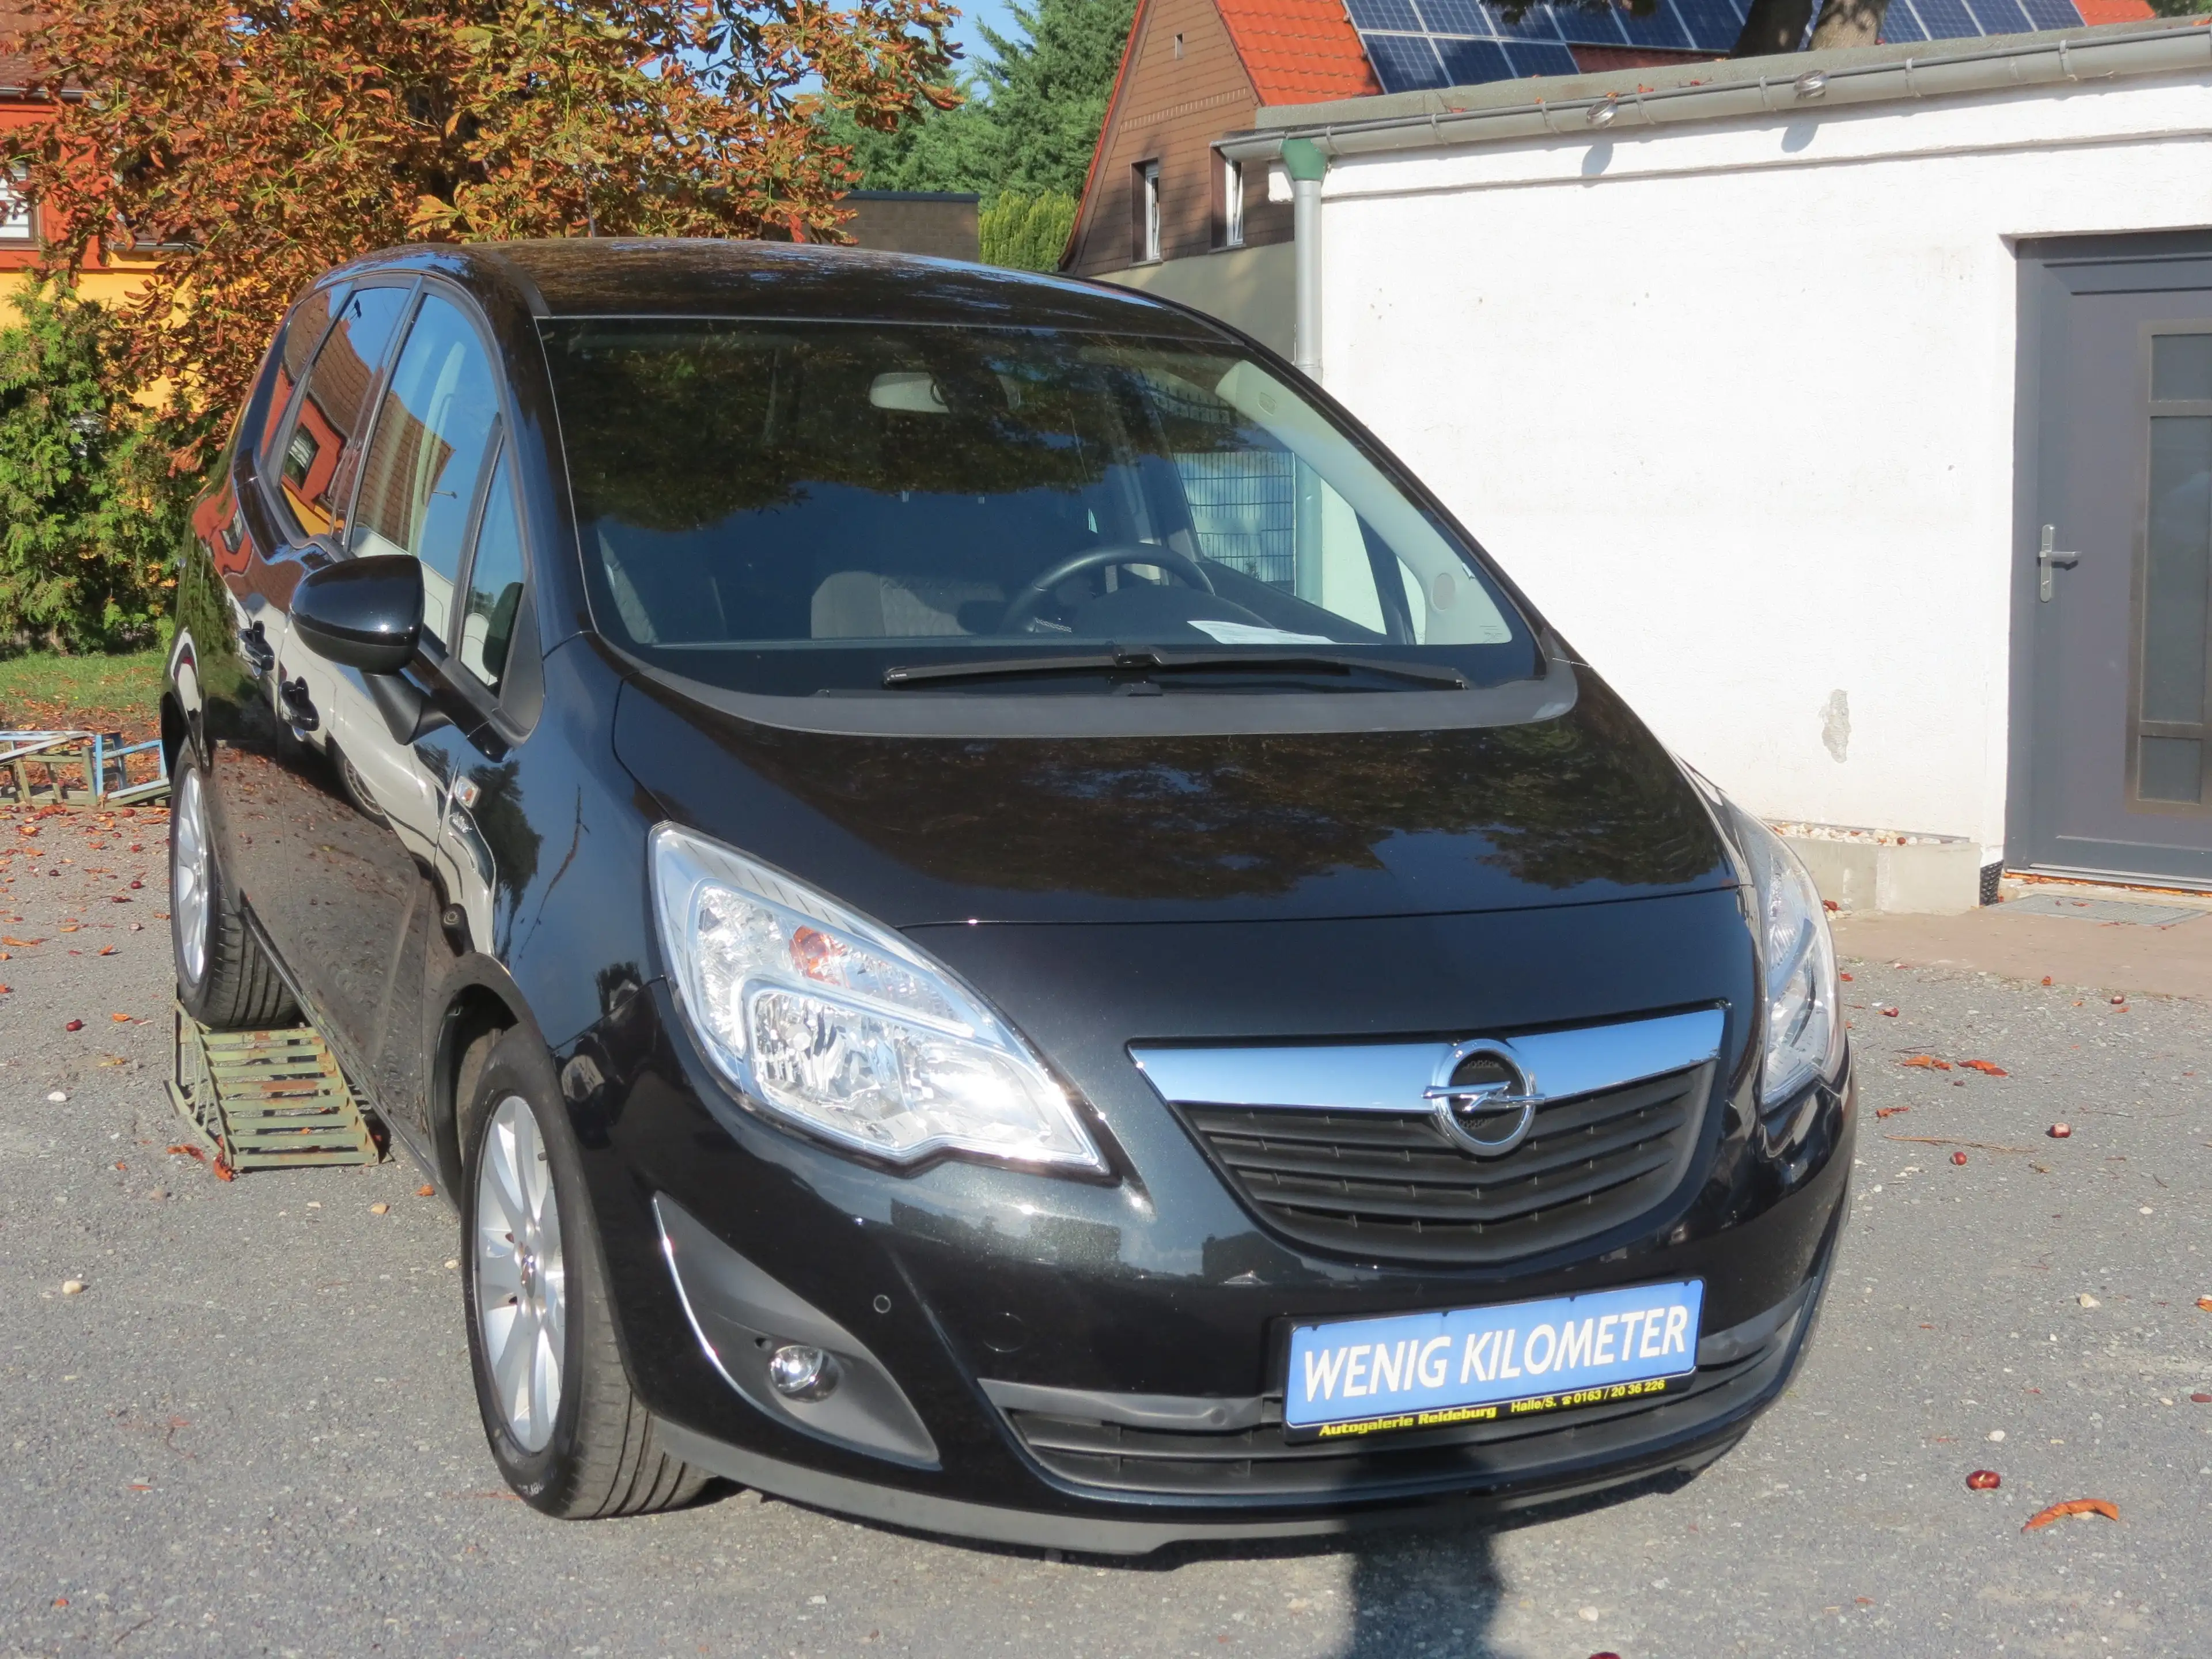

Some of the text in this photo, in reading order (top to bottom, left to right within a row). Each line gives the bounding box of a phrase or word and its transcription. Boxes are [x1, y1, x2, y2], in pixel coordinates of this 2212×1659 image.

[1305, 1305, 1688, 1402] WENIG KILOMETER
[1319, 1417, 1415, 1436] Autogalerie
[1418, 1407, 1498, 1425] Reideburg
[1510, 1397, 1557, 1412] Halle/S.
[1573, 1389, 1603, 1403] 0163
[1611, 1386, 1626, 1397] 20
[1627, 1383, 1642, 1395] 36
[1643, 1380, 1665, 1392] 226
